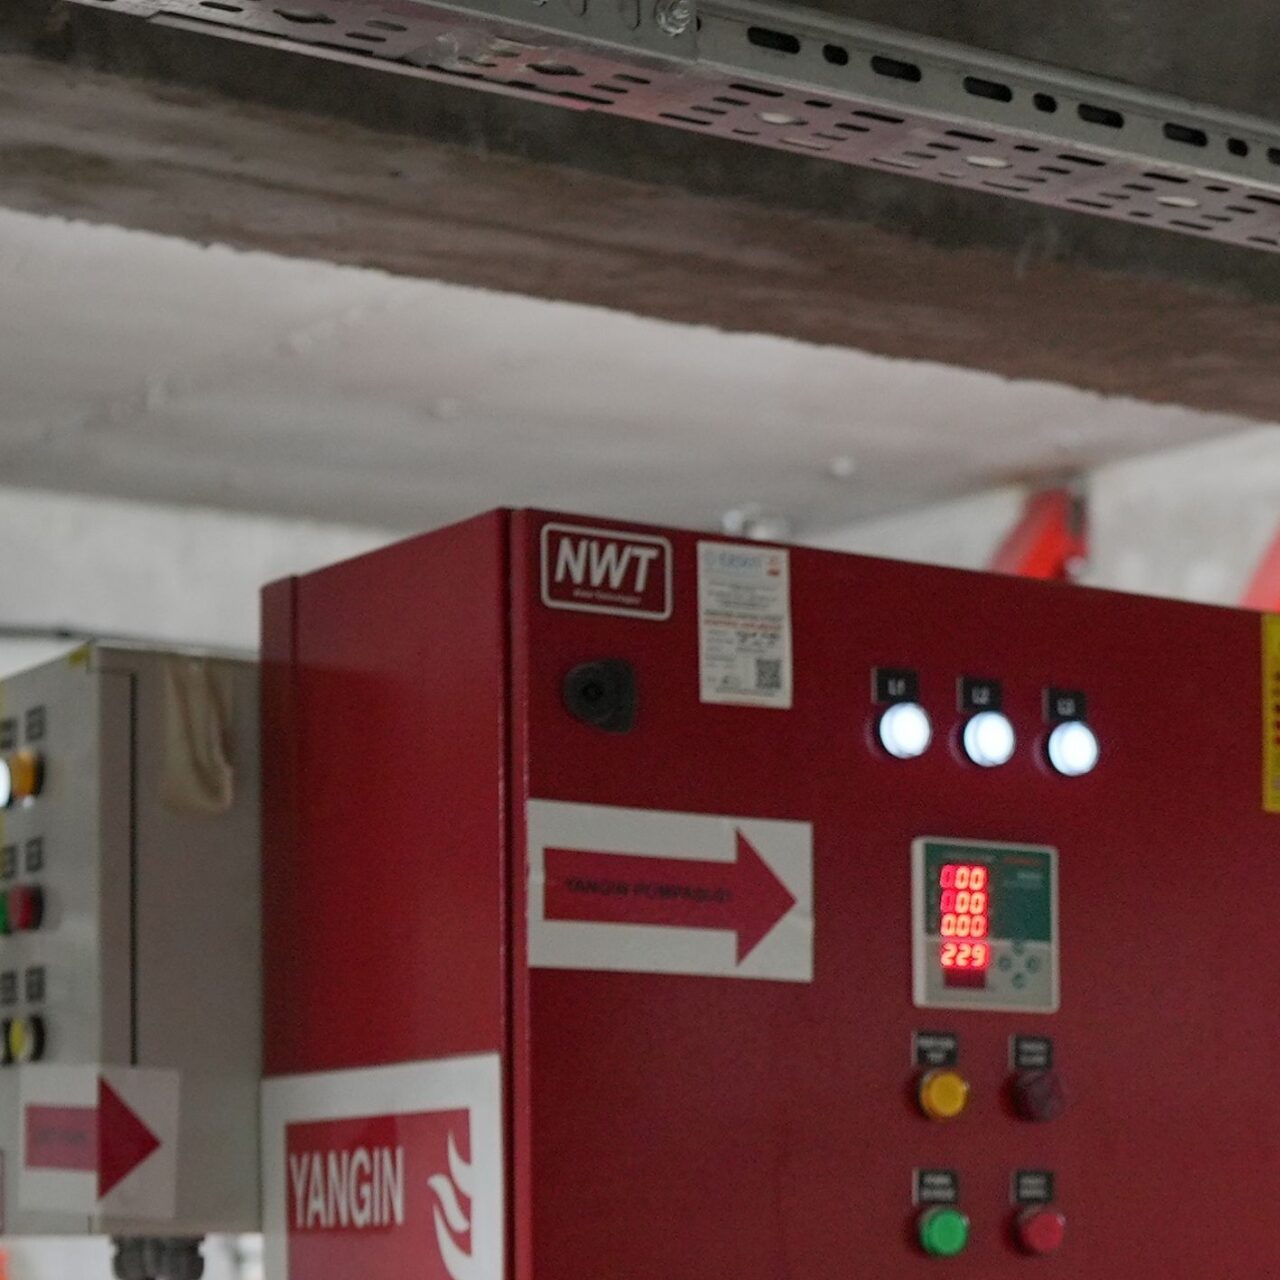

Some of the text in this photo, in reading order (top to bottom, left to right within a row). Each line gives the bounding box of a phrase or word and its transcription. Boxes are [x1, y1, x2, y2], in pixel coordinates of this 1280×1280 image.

[555, 537, 658, 592] NWT
[940, 942, 986, 967] 229
[290, 1146, 404, 1229] YANGIN
